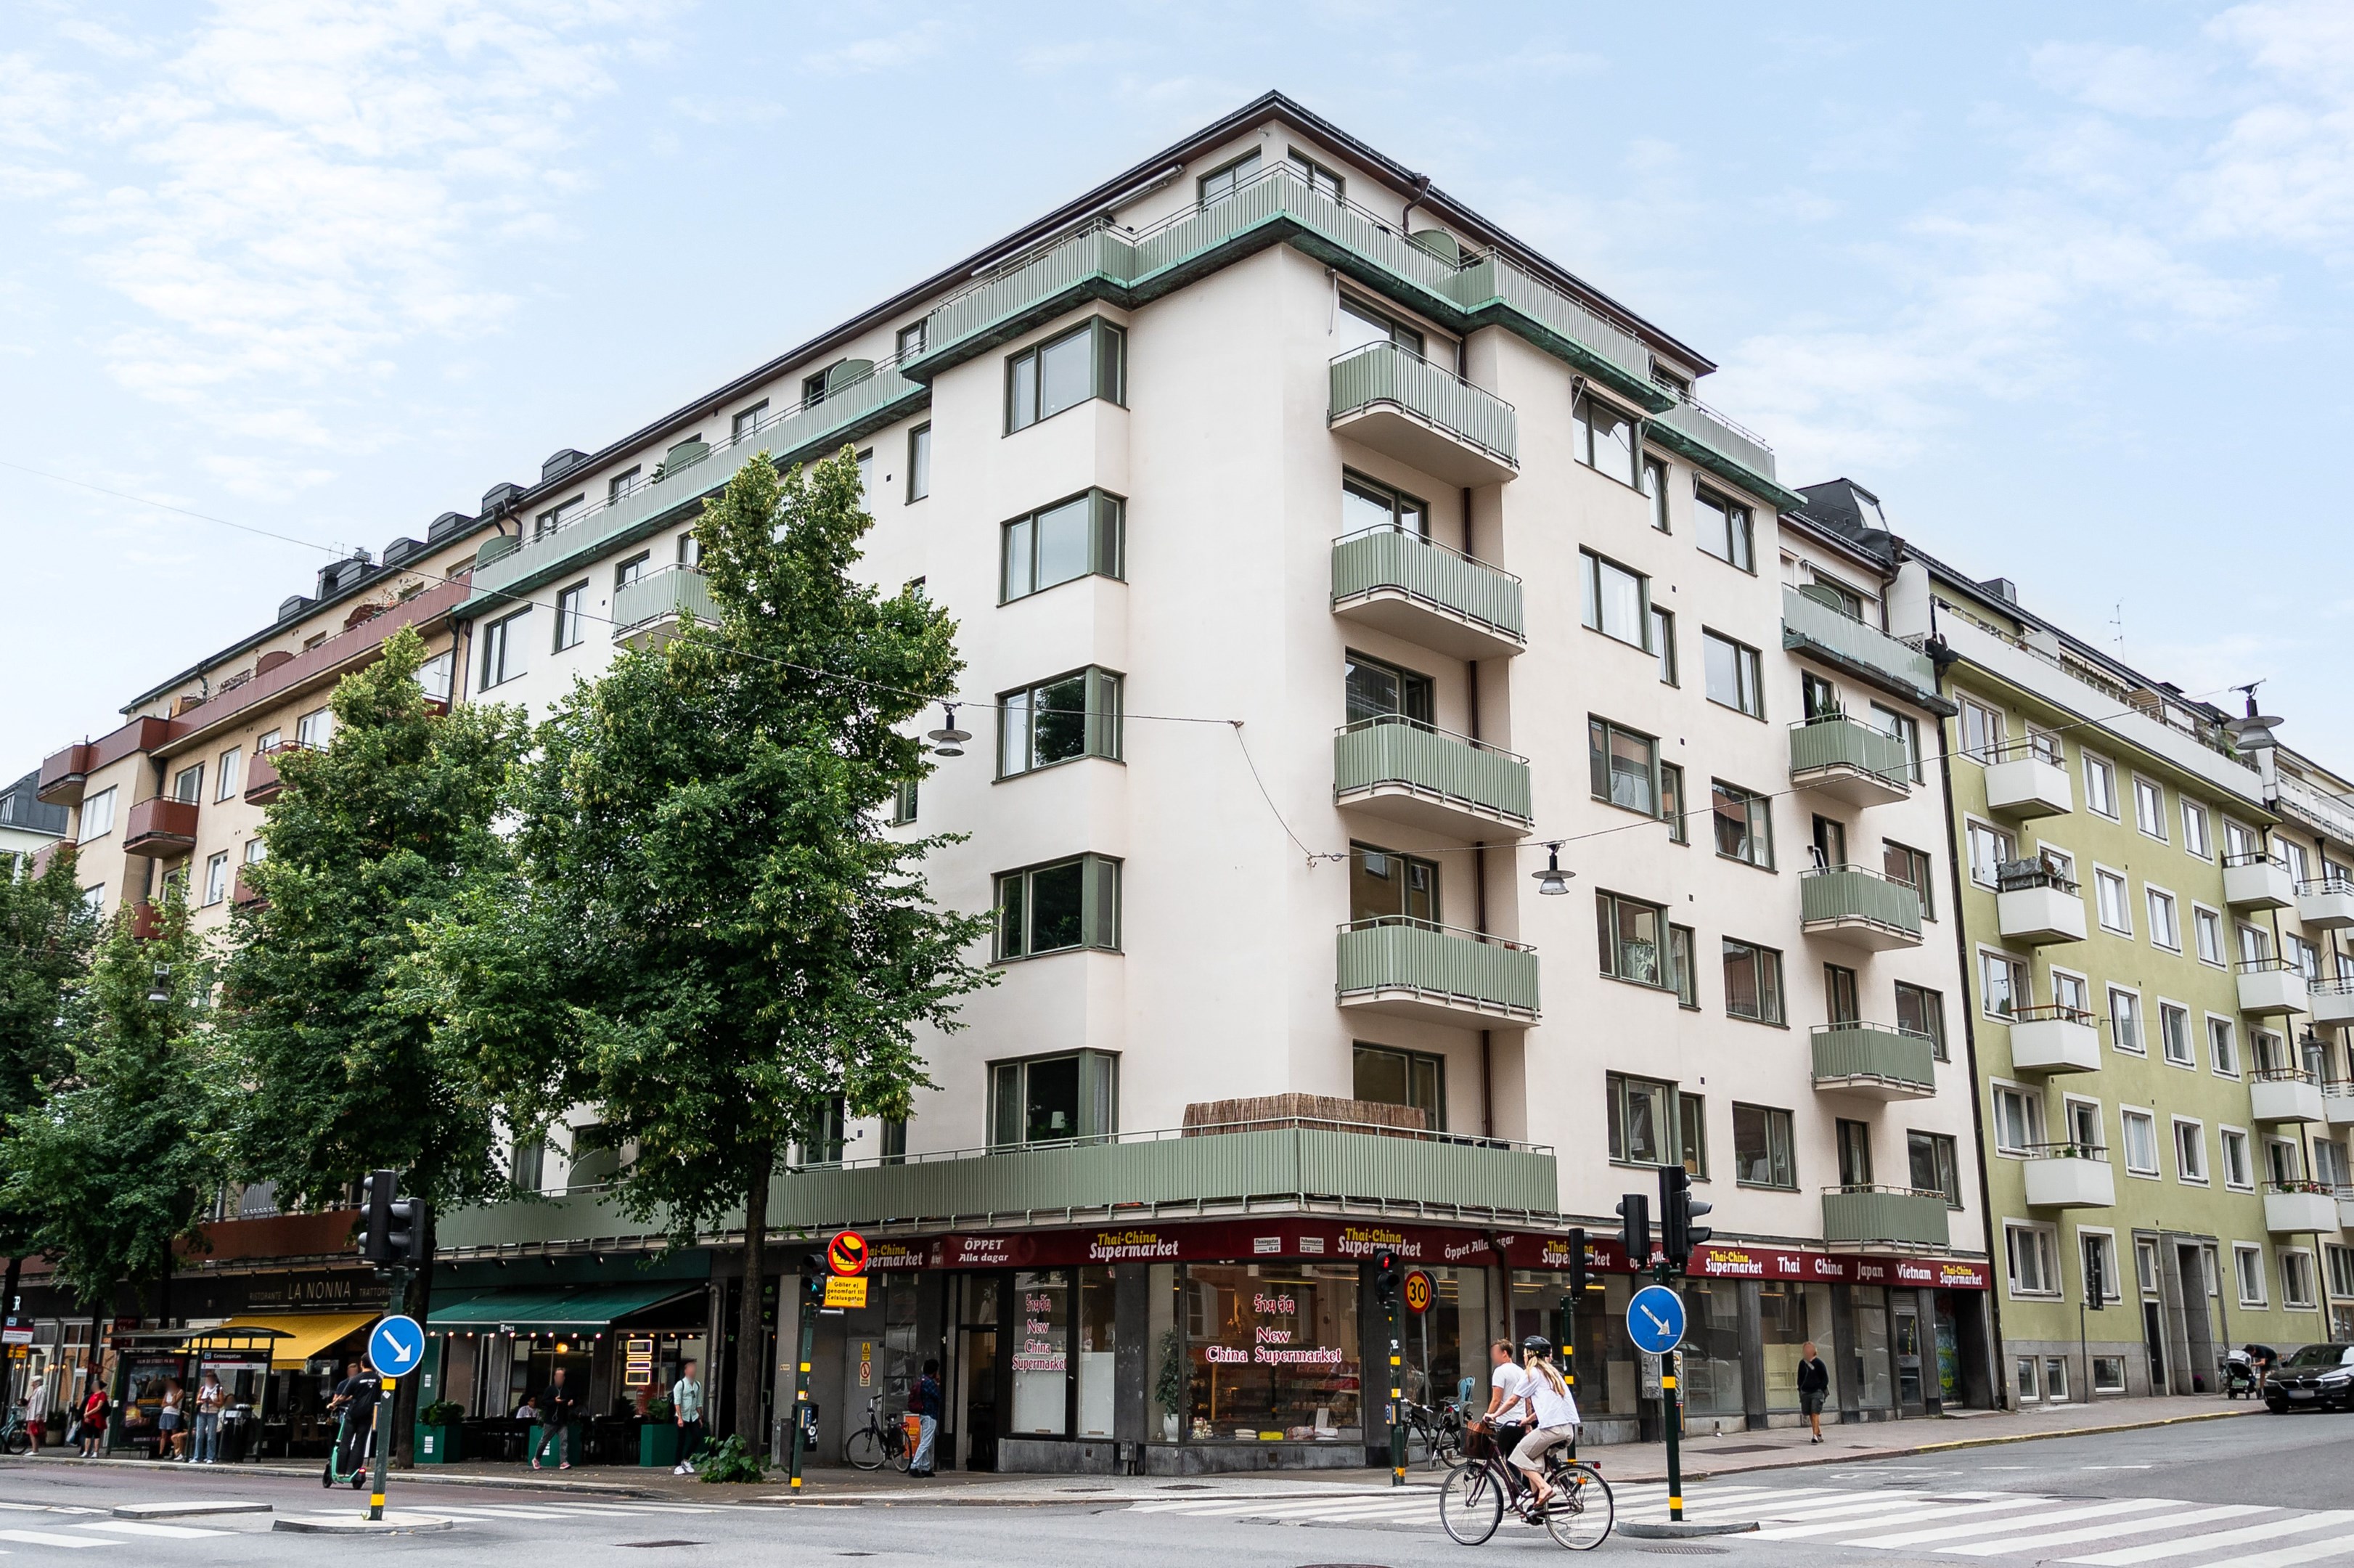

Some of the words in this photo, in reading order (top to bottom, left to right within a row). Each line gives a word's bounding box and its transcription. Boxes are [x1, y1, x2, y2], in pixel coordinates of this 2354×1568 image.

[964, 1237, 1004, 1250] ÖPPET
[1098, 1230, 1157, 1246] Thai-China
[1345, 1228, 1402, 1243] Thai-China
[1090, 1238, 1179, 1262] Supermarket
[1444, 1244, 1469, 1260] Öppet
[1471, 1238, 1489, 1252] Alla
[1548, 1240, 1593, 1253] Thai-na
[865, 1250, 923, 1271] permarket
[958, 1253, 978, 1262] Alla
[981, 1253, 1009, 1263] dagar
[1709, 1250, 1749, 1263] Thai-China
[1705, 1257, 1762, 1276] Supermarket
[1777, 1257, 1800, 1273] Thai
[1815, 1258, 1843, 1275] China
[1857, 1261, 1884, 1281] Japan
[1896, 1264, 1932, 1281] Vietnam
[1943, 1265, 1972, 1275] Thai-China
[1940, 1272, 1982, 1286] Supermarket
[249, 1291, 282, 1300] RISTORANTE
[288, 1283, 301, 1299] LA
[306, 1281, 351, 1299] NONNA
[359, 1287, 391, 1297] TRATTORIA
[1409, 1281, 1427, 1302] 30
[1027, 1318, 1050, 1334] New
[1256, 1326, 1291, 1343] New
[1024, 1339, 1051, 1355] China
[1206, 1345, 1248, 1363] China
[1254, 1345, 1342, 1365] Supermarket
[1012, 1354, 1067, 1373] Supermarket
